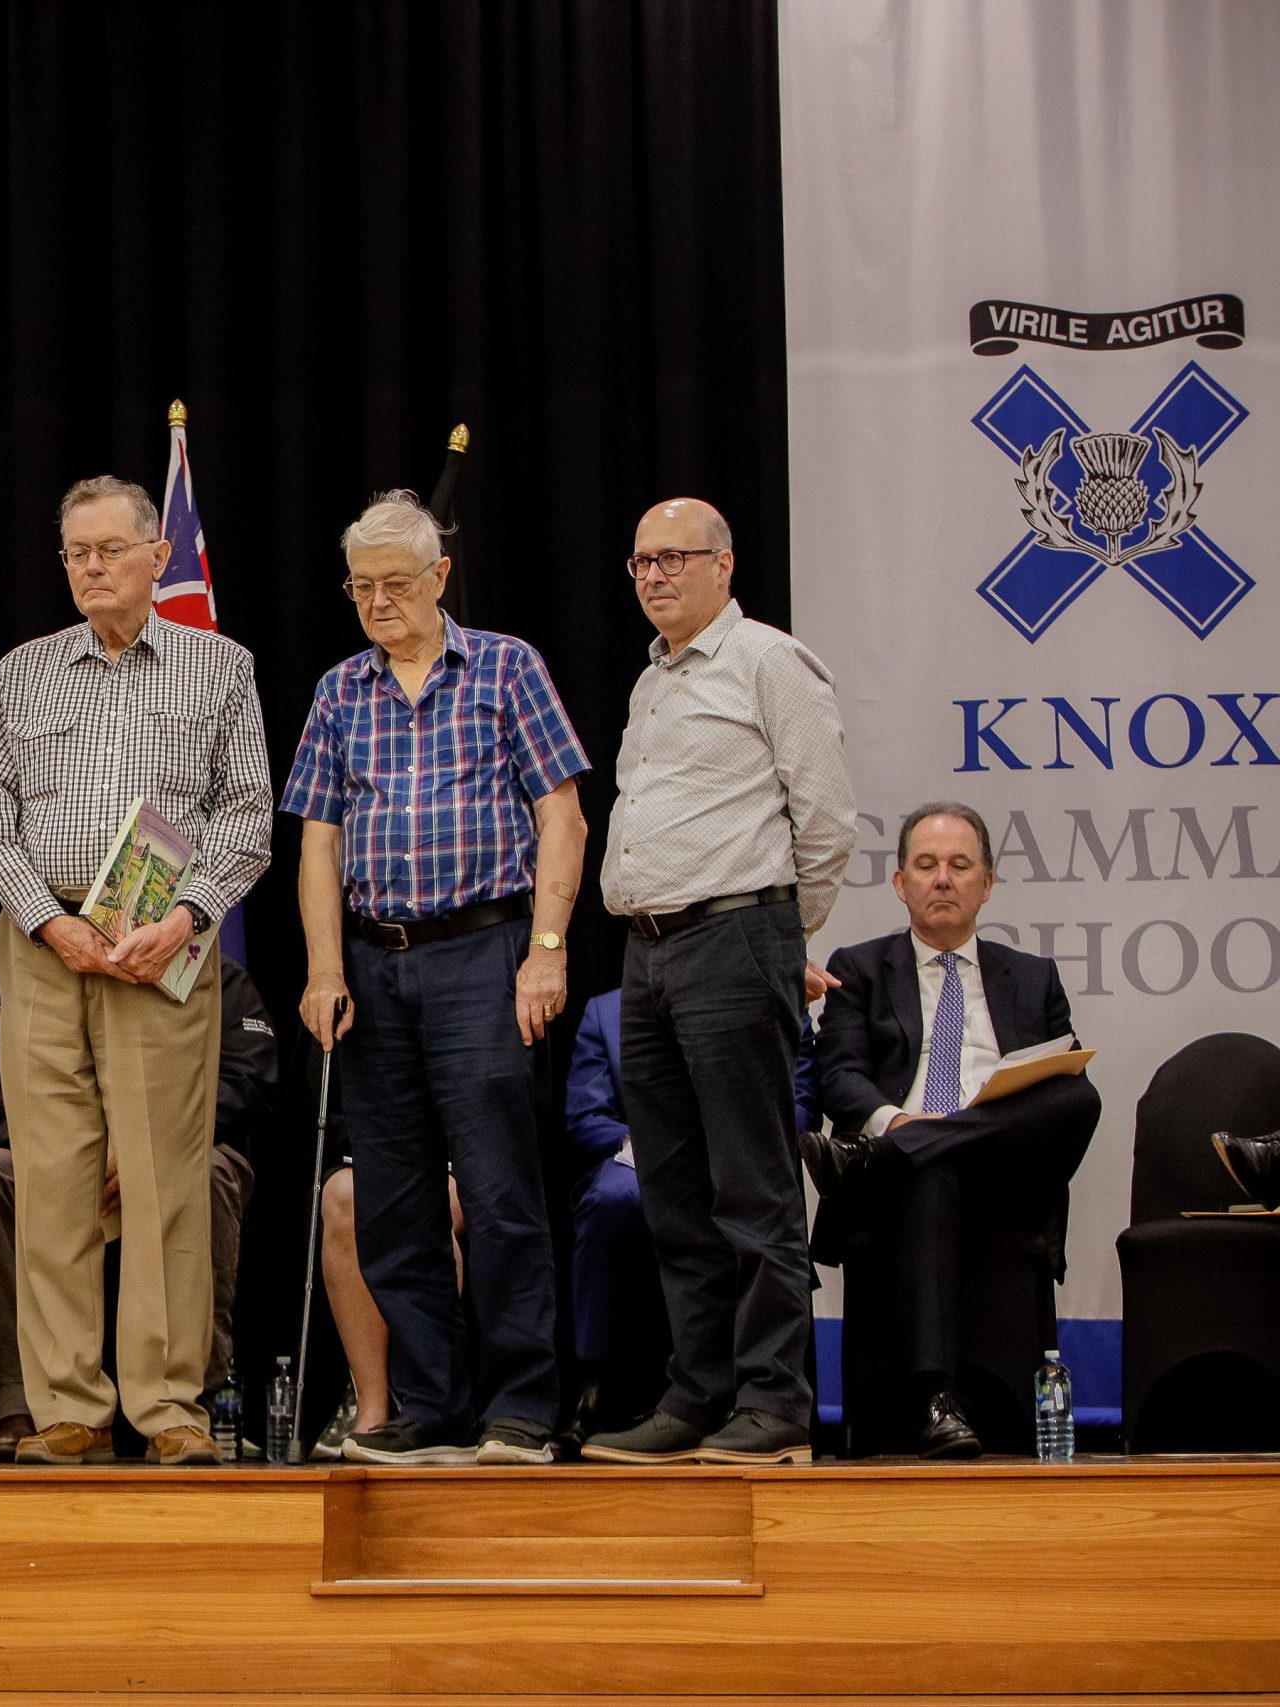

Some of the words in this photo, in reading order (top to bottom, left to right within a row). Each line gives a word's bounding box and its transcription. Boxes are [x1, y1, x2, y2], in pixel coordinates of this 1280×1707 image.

[988, 305, 1089, 344] VIRILE
[1106, 299, 1225, 345] AGITUR
[952, 693, 1280, 772] KNOX
